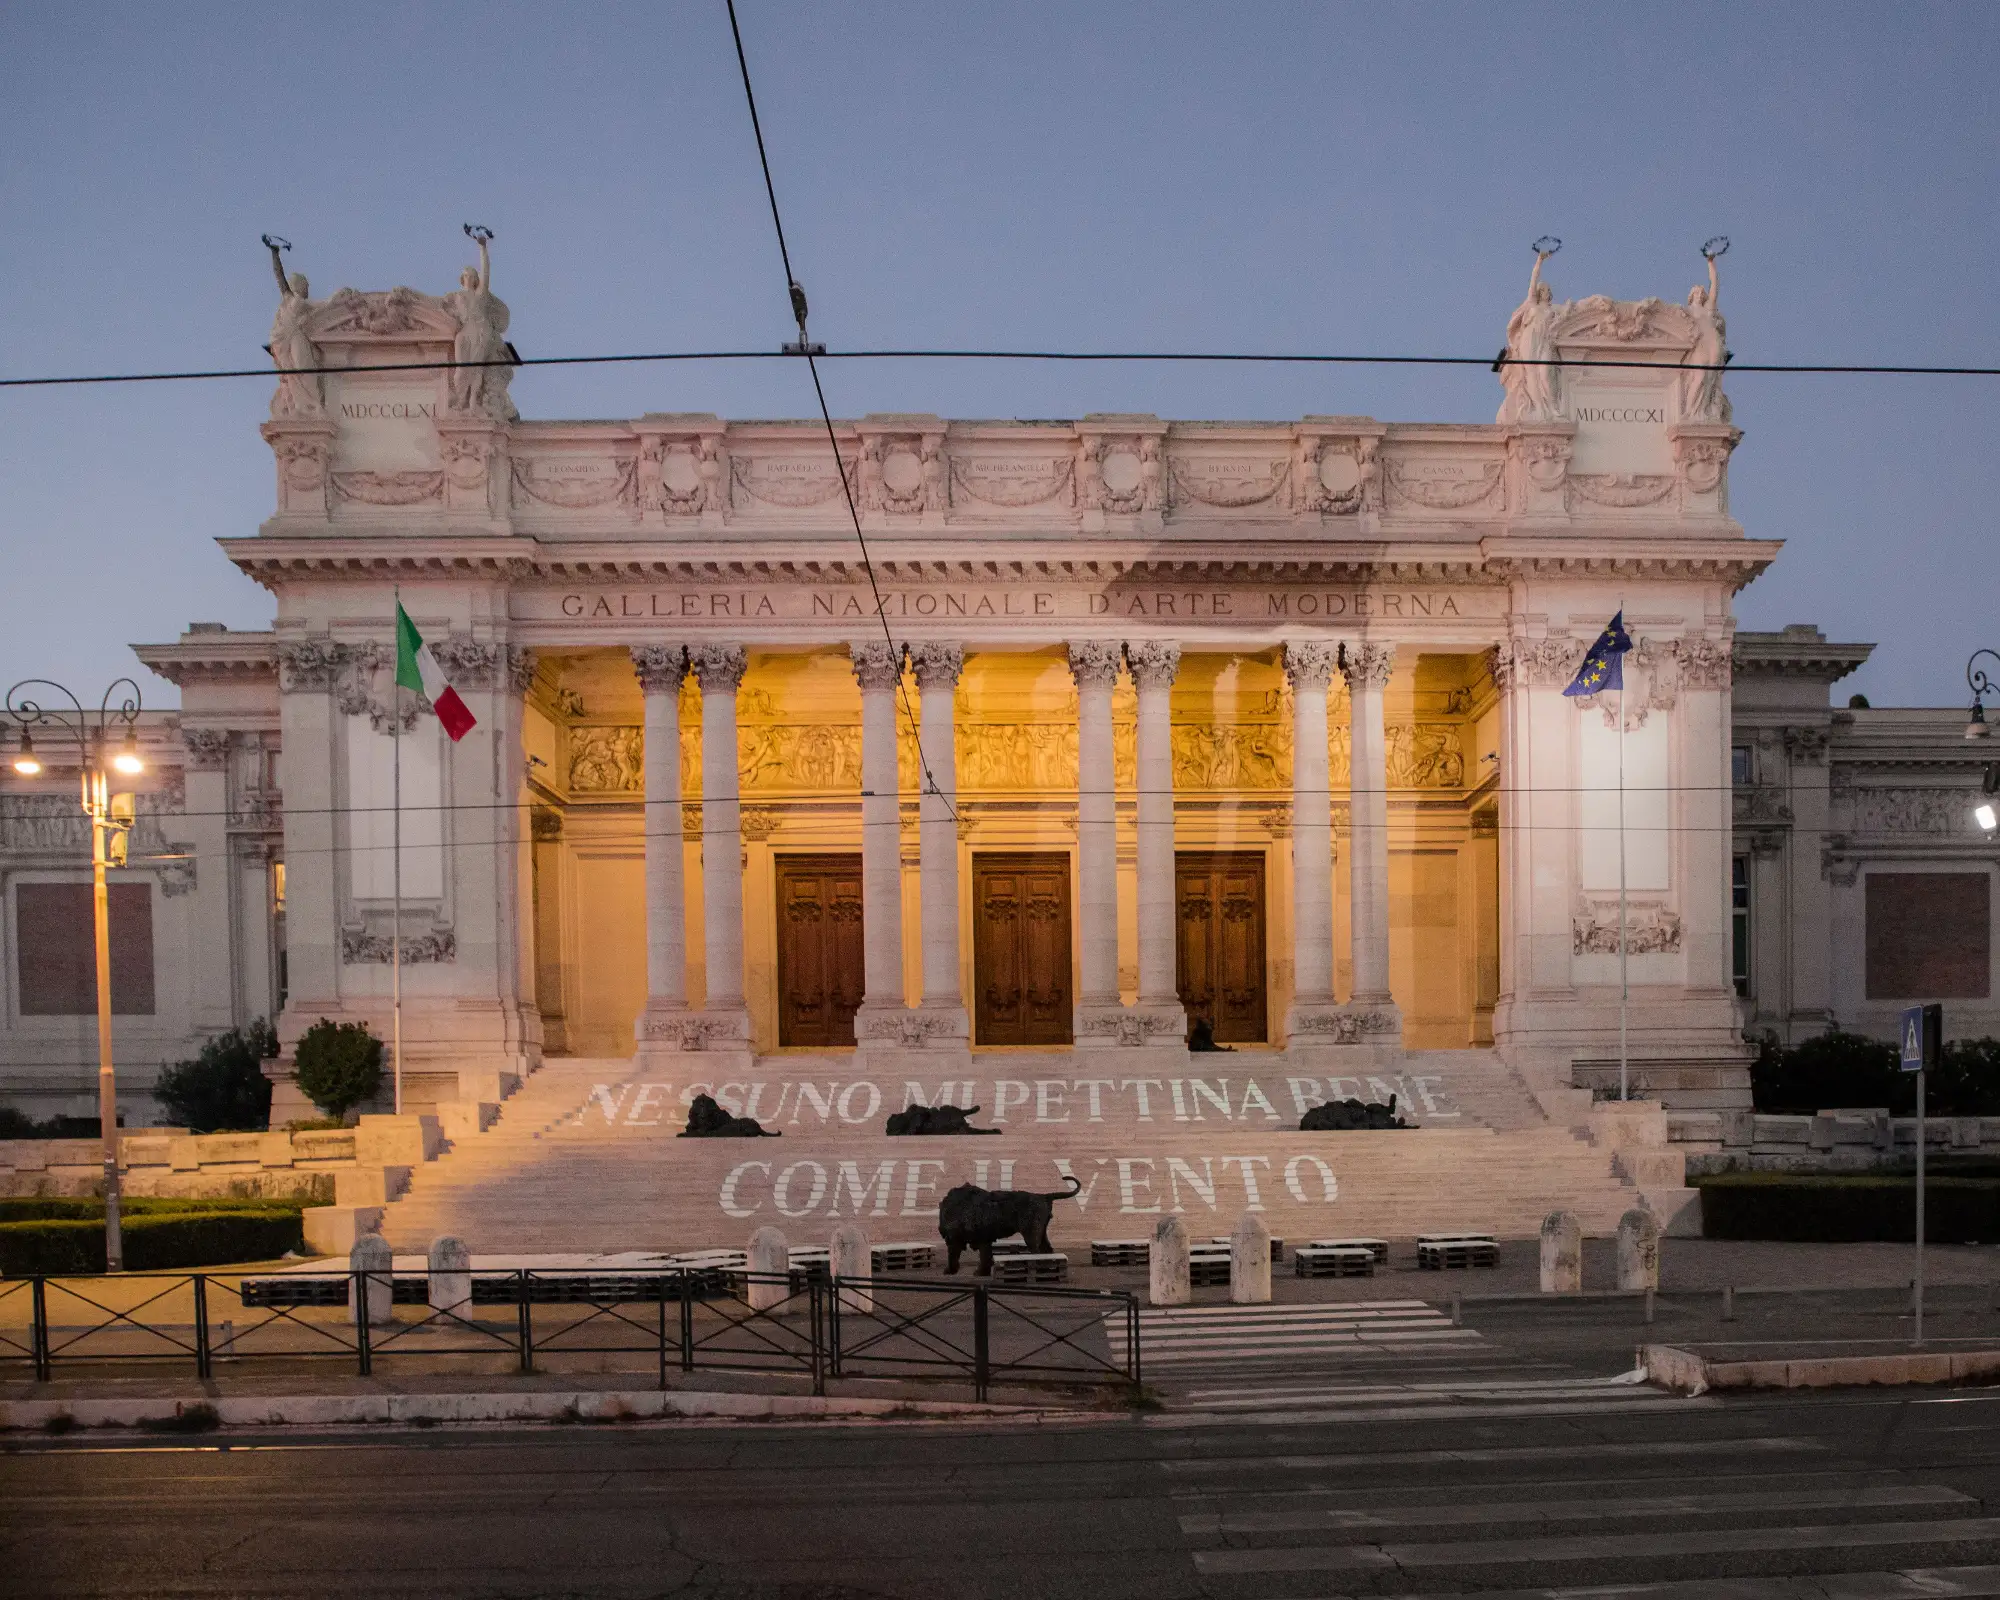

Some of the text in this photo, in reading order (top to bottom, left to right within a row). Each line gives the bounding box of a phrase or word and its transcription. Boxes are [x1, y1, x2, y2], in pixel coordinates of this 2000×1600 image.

[340, 403, 437, 418] MDCCCLXI
[1575, 407, 1665, 422] MDCCCCXI
[548, 465, 600, 473] LEONARDO
[767, 463, 822, 473] RAFFAELLO
[1207, 464, 1251, 473] BERNINI
[1422, 466, 1465, 475] CANOVA
[561, 592, 1461, 617] GALLERIA NAZIONALE D'ARTE MODERNA
[992, 1077, 1281, 1123] PETTINA
[718, 1160, 946, 1217] COME
[1052, 1154, 1339, 1213] VENTO
